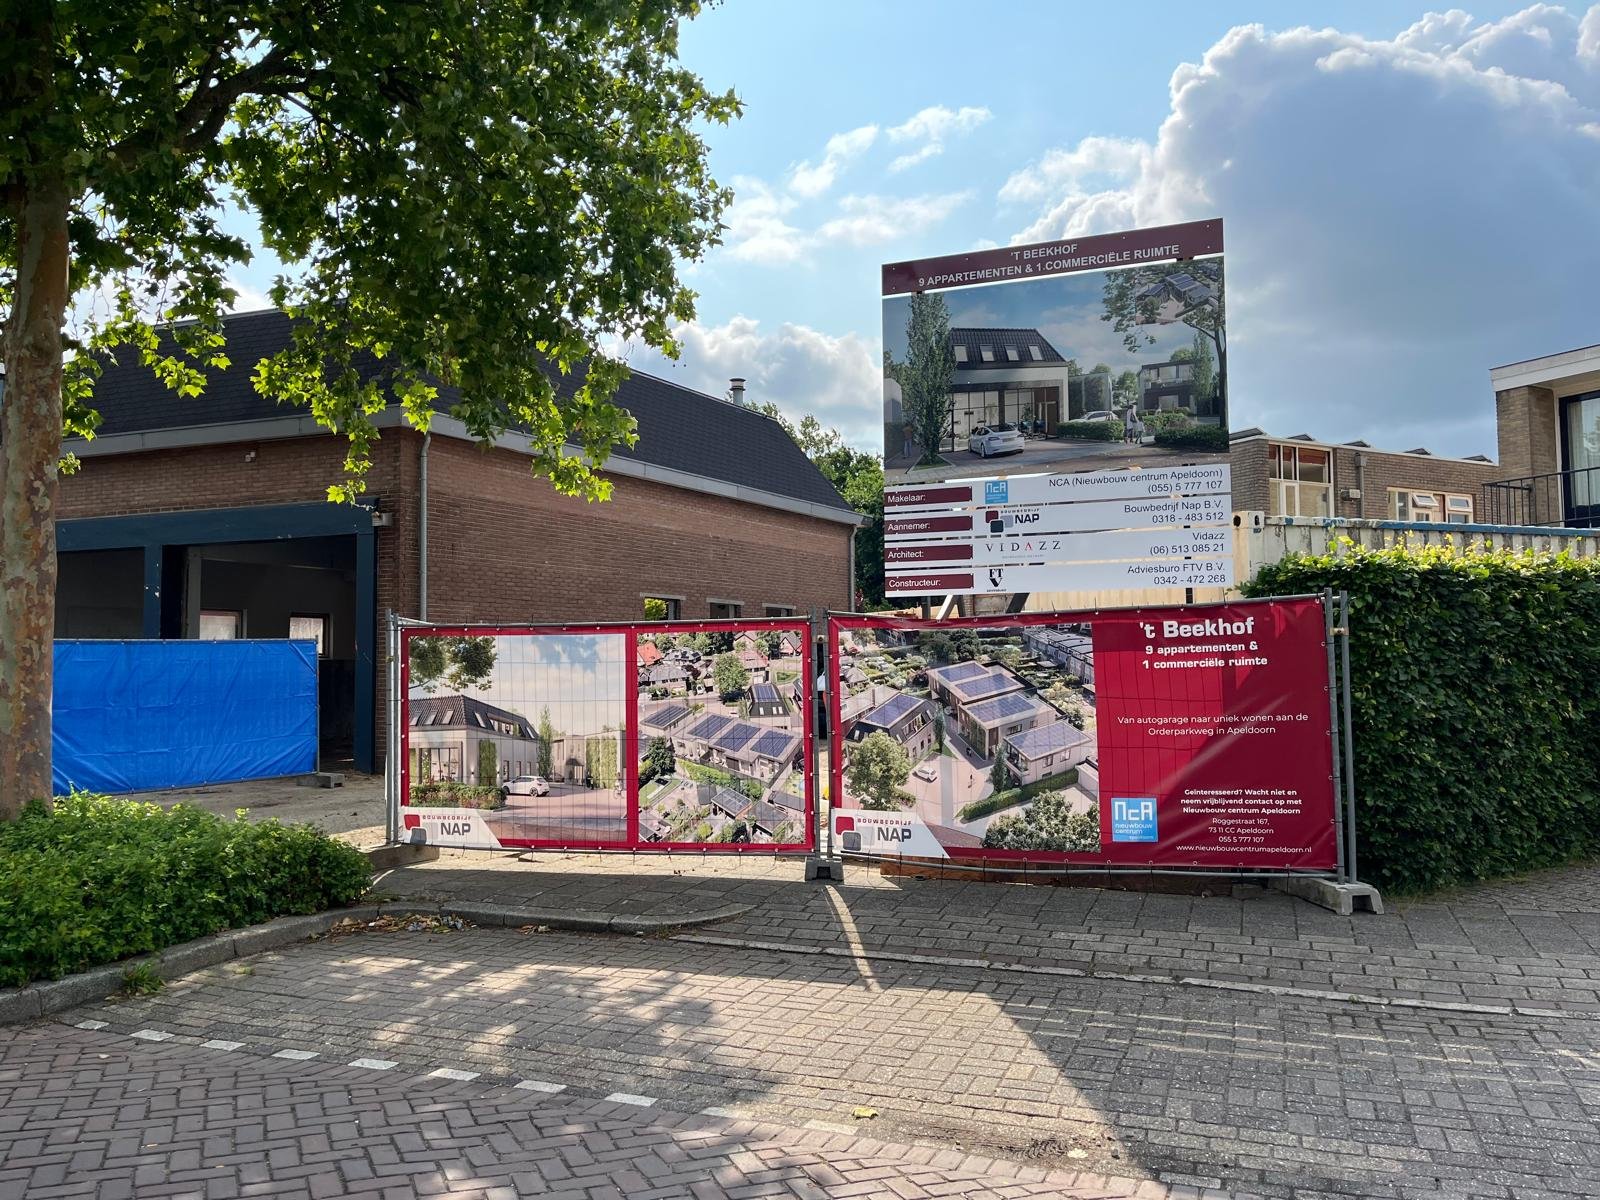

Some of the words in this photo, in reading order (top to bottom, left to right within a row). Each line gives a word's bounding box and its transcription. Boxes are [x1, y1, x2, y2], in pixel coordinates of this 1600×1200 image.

[1010, 251, 1020, 260] 'T
[1023, 244, 1078, 260] BEEKHOF
[918, 278, 924, 286] 9
[927, 266, 1022, 286] APPARTEMENTEN
[1025, 264, 1033, 273] &
[1134, 244, 1180, 260] RUIMTE
[1049, 477, 1070, 487] NCA
[1072, 476, 1127, 487] (Nieuwbouw
[1131, 472, 1168, 482] centrum
[1148, 484, 1173, 494] (055)
[1175, 482, 1181, 491] 5
[1185, 482, 1201, 491] 777
[1206, 480, 1223, 489] 107
[887, 494, 926, 503] Makelaar:
[1124, 502, 1179, 513] Bouwbedrijf
[1181, 501, 1201, 511] Nap
[1204, 500, 1224, 508] B.V.
[1015, 514, 1040, 524] NAP
[1152, 514, 1176, 523] 0318
[1184, 512, 1203, 522] 483
[1205, 511, 1223, 521] 512
[887, 523, 930, 531] Aannemer:
[1192, 532, 1225, 540] Vidazz
[986, 540, 1061, 552] VIDAZZ
[1150, 546, 1169, 556] (06)
[1172, 544, 1189, 553] 513
[1192, 544, 1210, 552] 085
[1213, 543, 1224, 552] 21
[1128, 565, 1180, 574] Adviesburo
[1183, 563, 1203, 571] FTV
[1206, 562, 1225, 570] B.V.
[888, 579, 941, 588] Constructeur:
[1154, 576, 1177, 584] 0342
[1187, 575, 1205, 583] 472
[1208, 574, 1226, 583] 268
[1139, 621, 1156, 639] 't
[1163, 617, 1255, 638] Beekhof
[1145, 645, 1153, 655] 9
[1157, 643, 1245, 656] appartementen
[1249, 641, 1258, 650] &
[1142, 660, 1149, 669] 1
[1154, 657, 1225, 669] commerciële
[1228, 656, 1268, 666] ruimte
[1136, 716, 1189, 725] autogarage
[1213, 714, 1239, 723] uniek
[1296, 713, 1308, 721] de
[1148, 727, 1214, 737] Orderparkweg
[1227, 726, 1276, 735] Apeldoorn
[440, 822, 471, 836] NAP
[877, 827, 912, 842] NAP
[1176, 845, 1312, 853] www.nieuwbouwcentrumapeldoorn.nl
